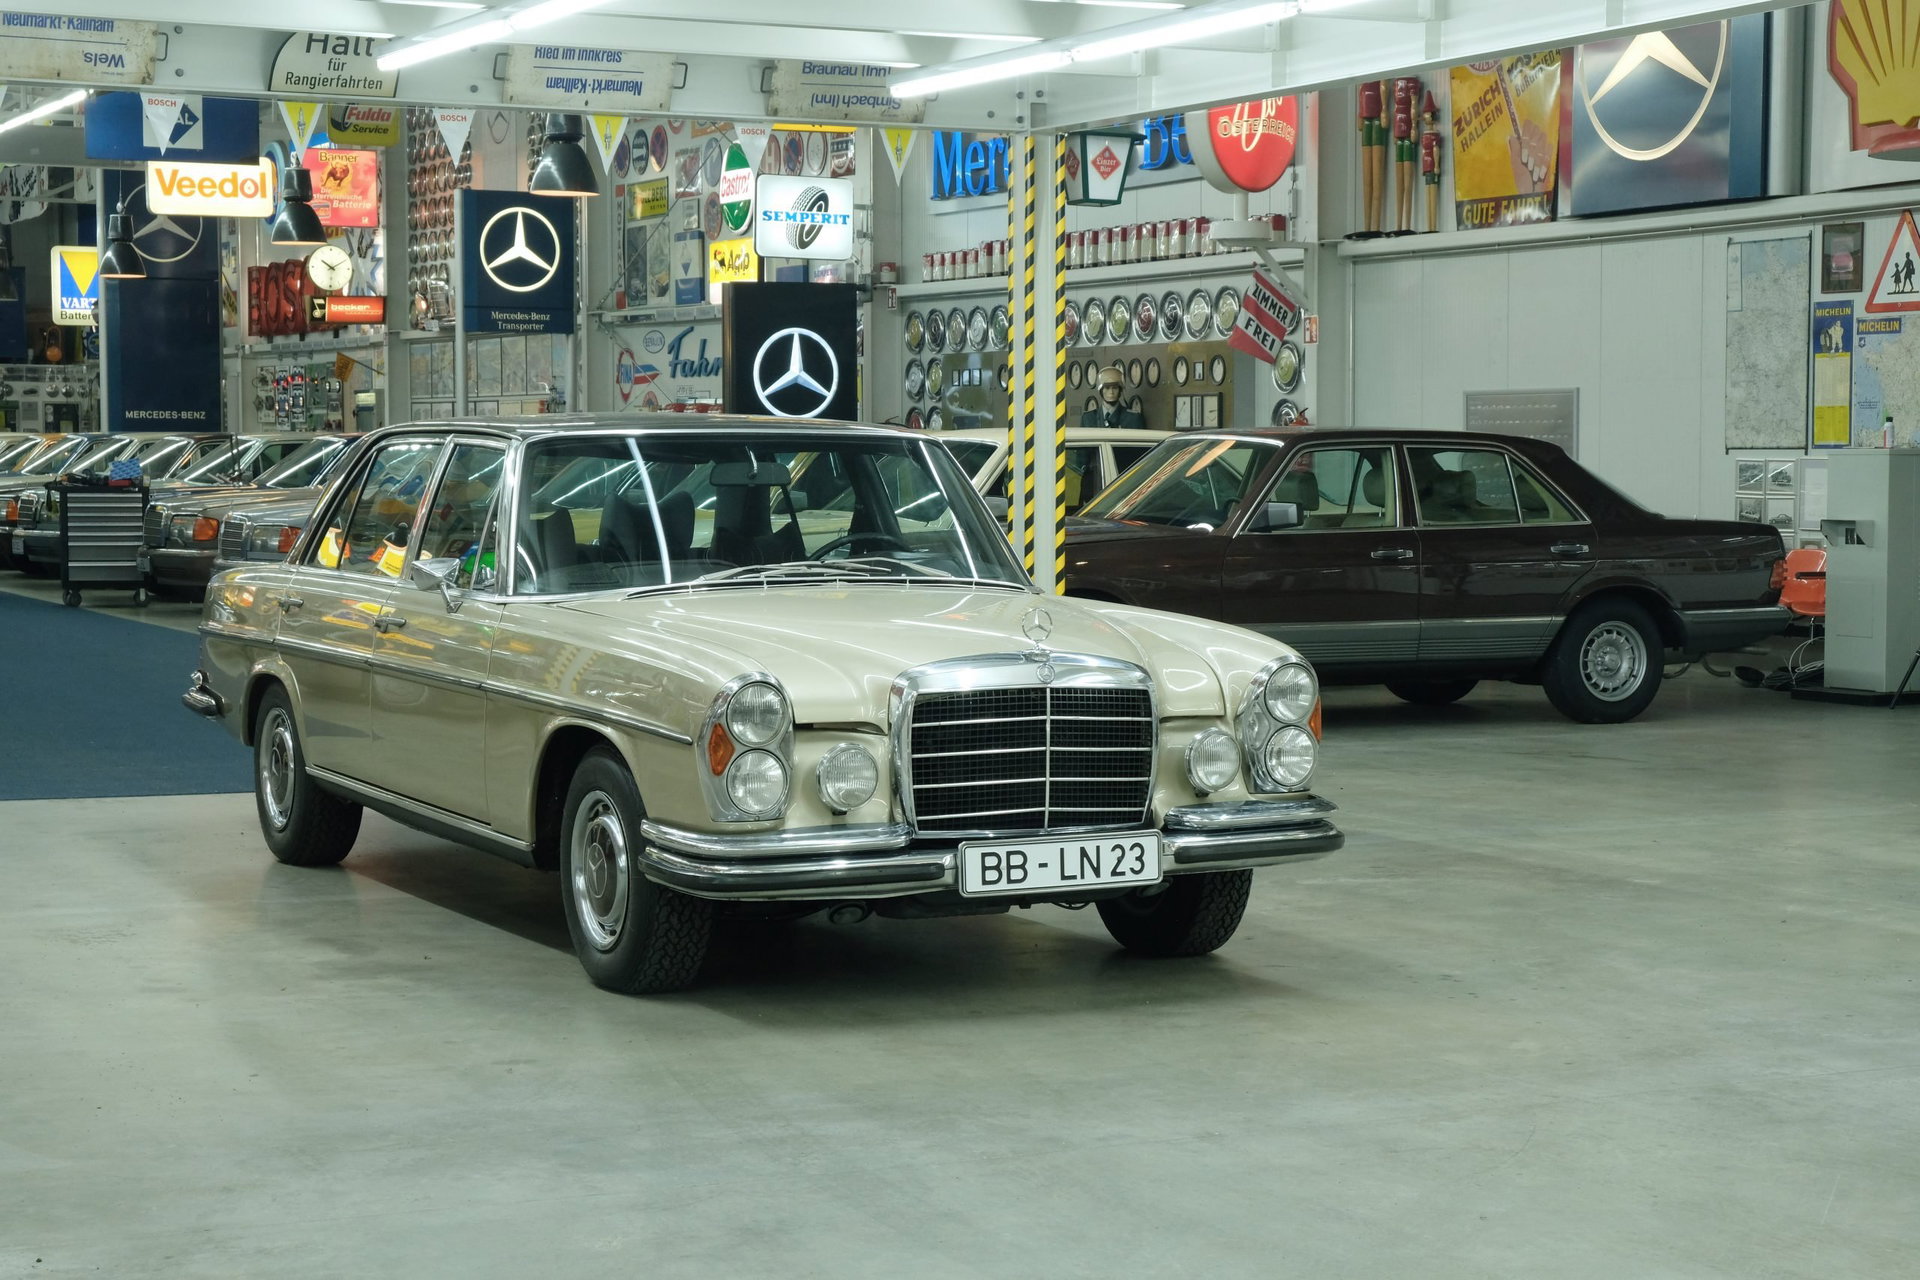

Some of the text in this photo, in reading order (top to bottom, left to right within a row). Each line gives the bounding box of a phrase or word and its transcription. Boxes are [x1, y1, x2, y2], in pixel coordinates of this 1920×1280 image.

[304, 32, 376, 57] Halt
[83, 52, 126, 69] Wels
[561, 47, 576, 60] im
[327, 57, 347, 72] für
[802, 61, 858, 77] Braunau
[284, 71, 384, 90] Rangierfahrten
[147, 97, 178, 108] BOSCH
[810, 92, 902, 110] Simbach (Inn)
[1453, 80, 1502, 137] ZÜRICH
[345, 106, 392, 122] Fulda
[440, 114, 467, 122] BOSCH
[351, 124, 390, 135] Service
[740, 127, 766, 136] BOSCH
[1460, 101, 1504, 152] HALLEIN
[319, 151, 359, 163] Banner
[154, 167, 268, 199] Veedol
[762, 210, 850, 225] SEMPERIT
[1463, 201, 1496, 225] GUTE
[1252, 283, 1288, 325] ZIMMER
[491, 311, 551, 321] Mercedes-Benz
[1815, 307, 1851, 318] MICHELIN
[497, 321, 545, 332] Transporter
[1244, 316, 1276, 352] FREI
[1858, 320, 1900, 333] MICHELIN
[1110, 842, 1145, 877] 23
